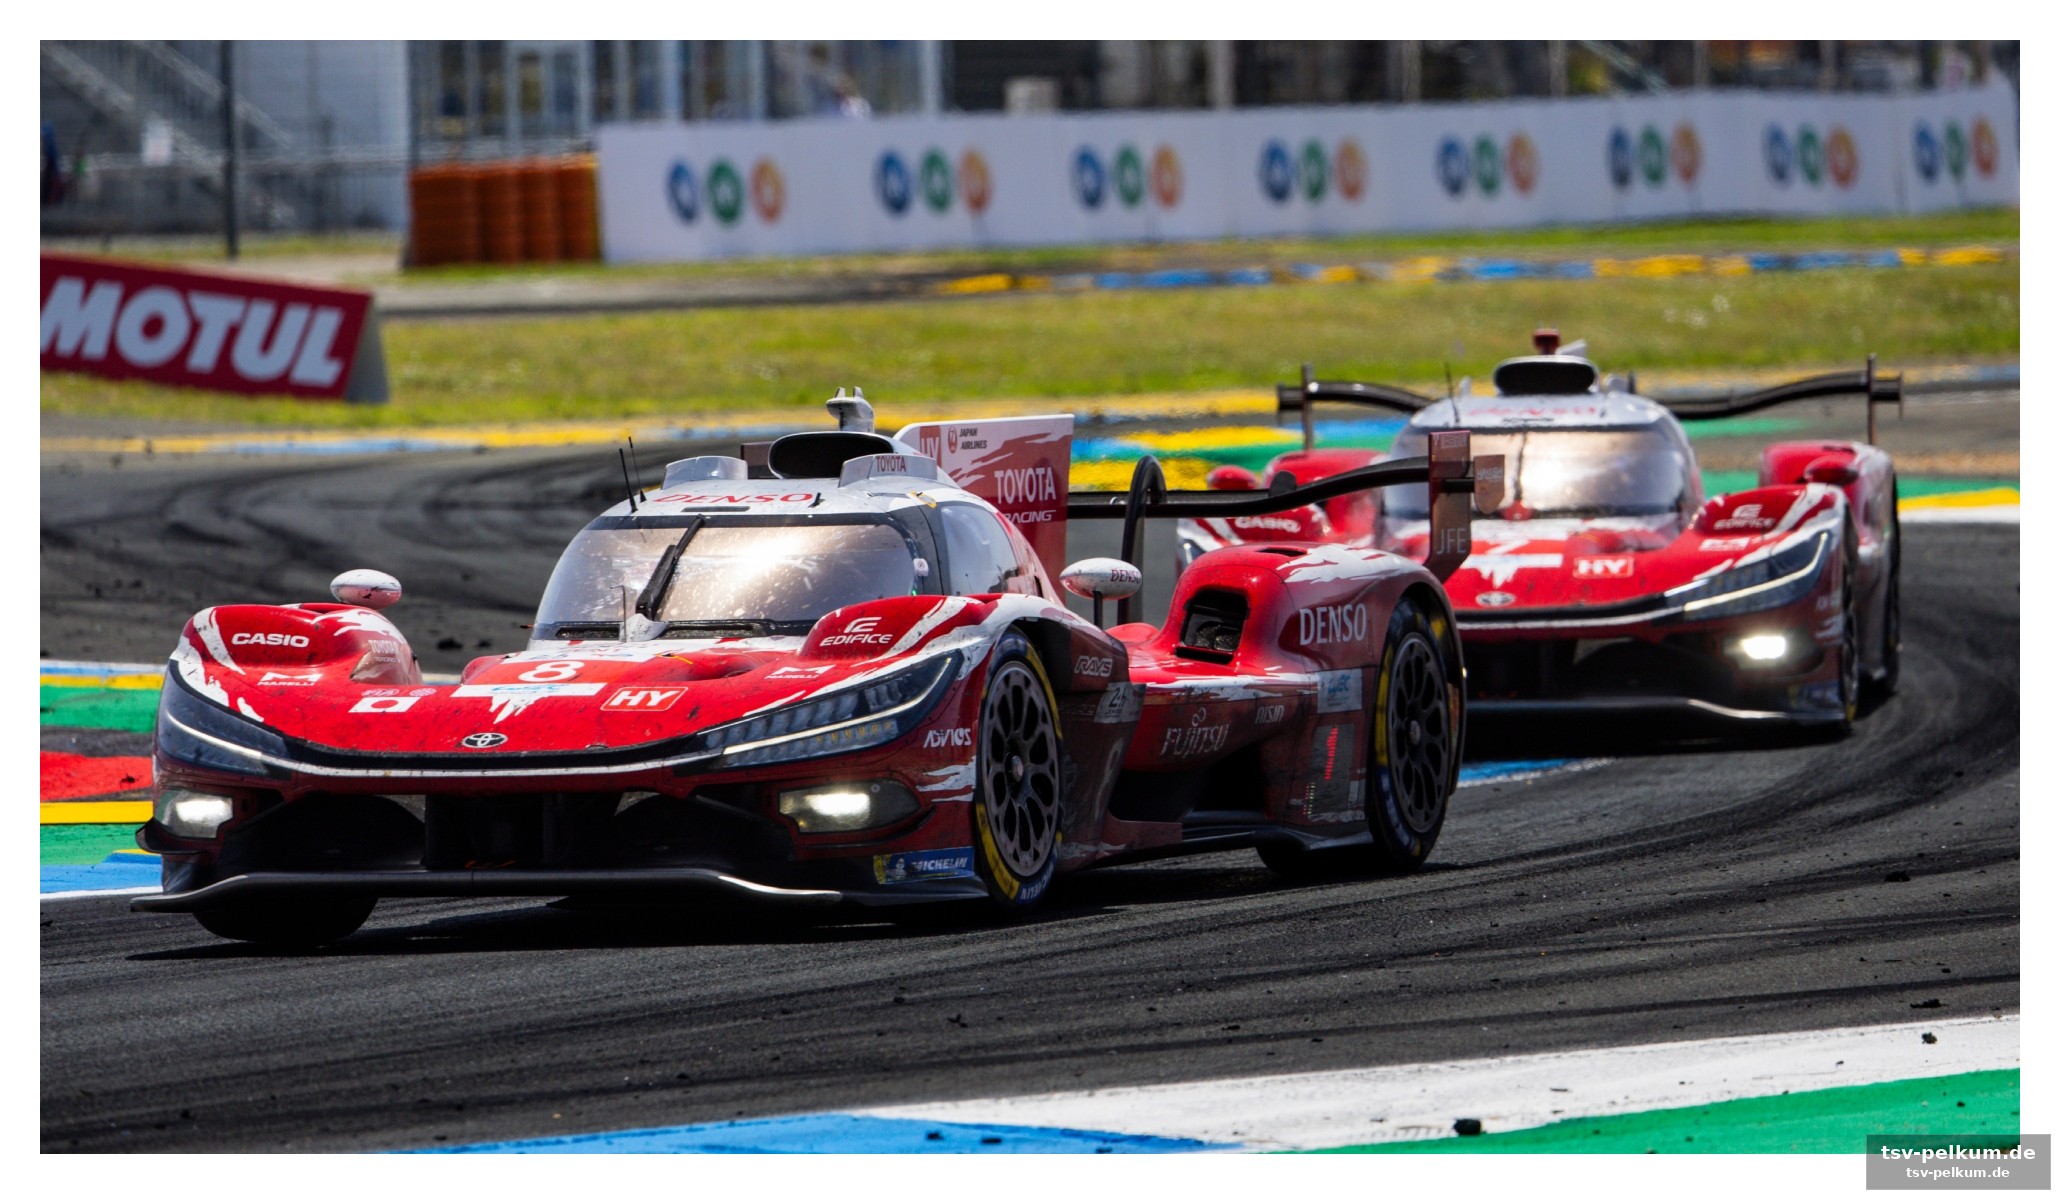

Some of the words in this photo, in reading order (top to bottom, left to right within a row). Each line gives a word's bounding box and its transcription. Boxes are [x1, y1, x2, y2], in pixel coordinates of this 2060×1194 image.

[40, 275, 345, 388] MOTUL
[959, 428, 978, 437] JAPAN
[960, 440, 987, 450] AIRLINES
[876, 455, 907, 472] TOYOTA
[994, 466, 1057, 504] TOYOTA
[654, 493, 813, 503] DENSO
[1437, 528, 1467, 554] JFE
[1576, 559, 1627, 574] HY
[1300, 603, 1367, 646] DENSO
[231, 633, 310, 648] CASIO
[820, 634, 894, 647] EDIFICE
[518, 661, 586, 682] 8
[1074, 655, 1113, 677] RAYS
[608, 690, 681, 706] HY
[1255, 704, 1285, 724] AISIN
[1160, 723, 1230, 759] FUJITSU
